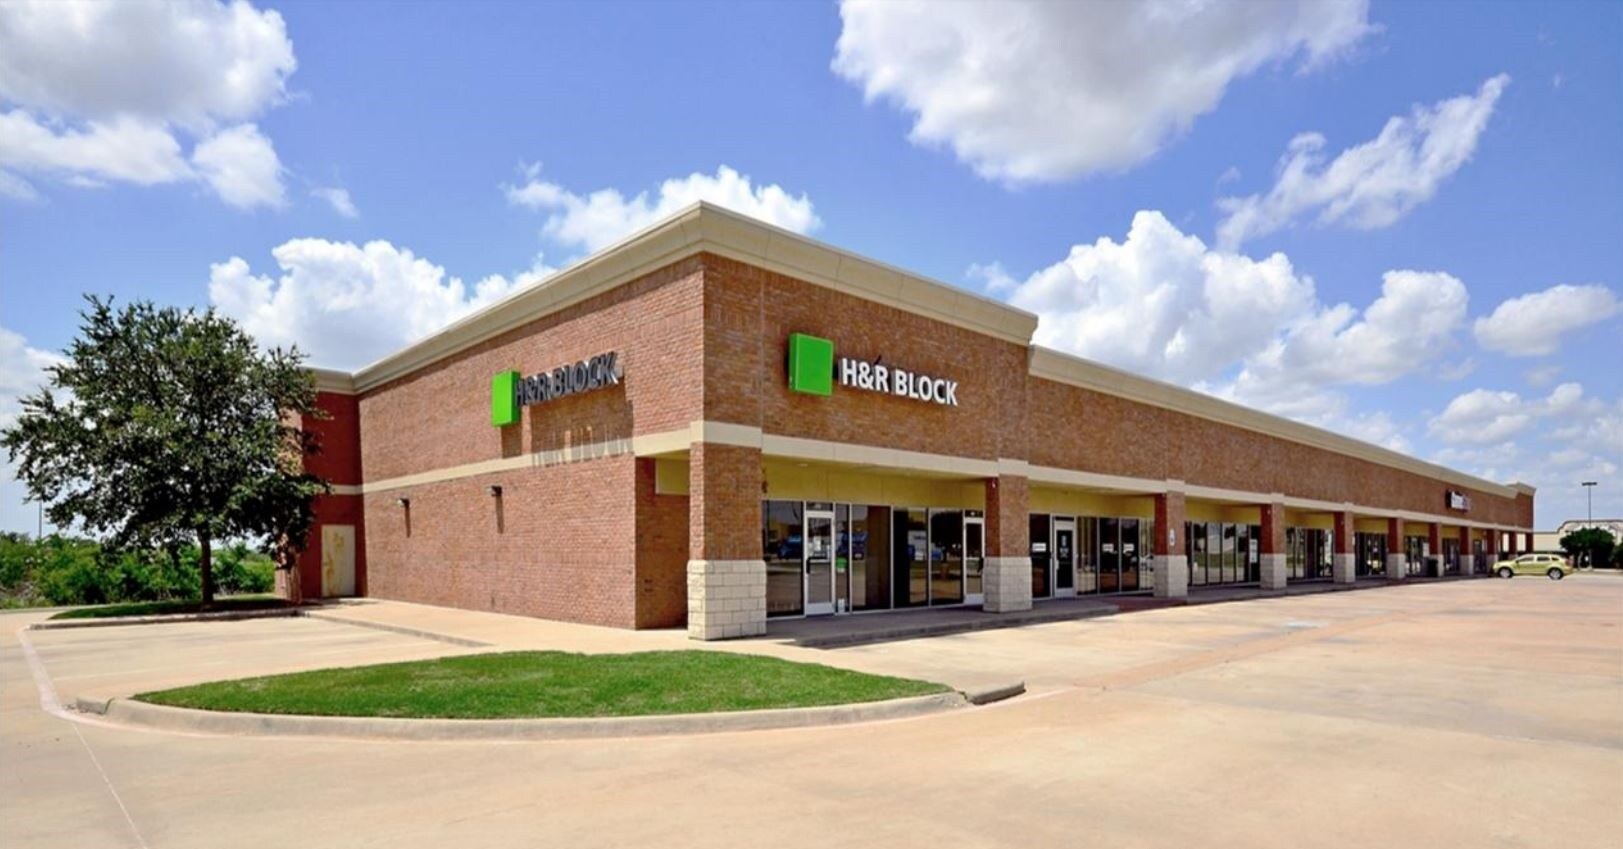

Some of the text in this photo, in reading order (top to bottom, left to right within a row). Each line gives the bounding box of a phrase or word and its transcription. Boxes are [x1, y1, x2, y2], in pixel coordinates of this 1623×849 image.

[514, 351, 618, 406] H&R BLOCK
[841, 358, 958, 406] H&R BLOCK
